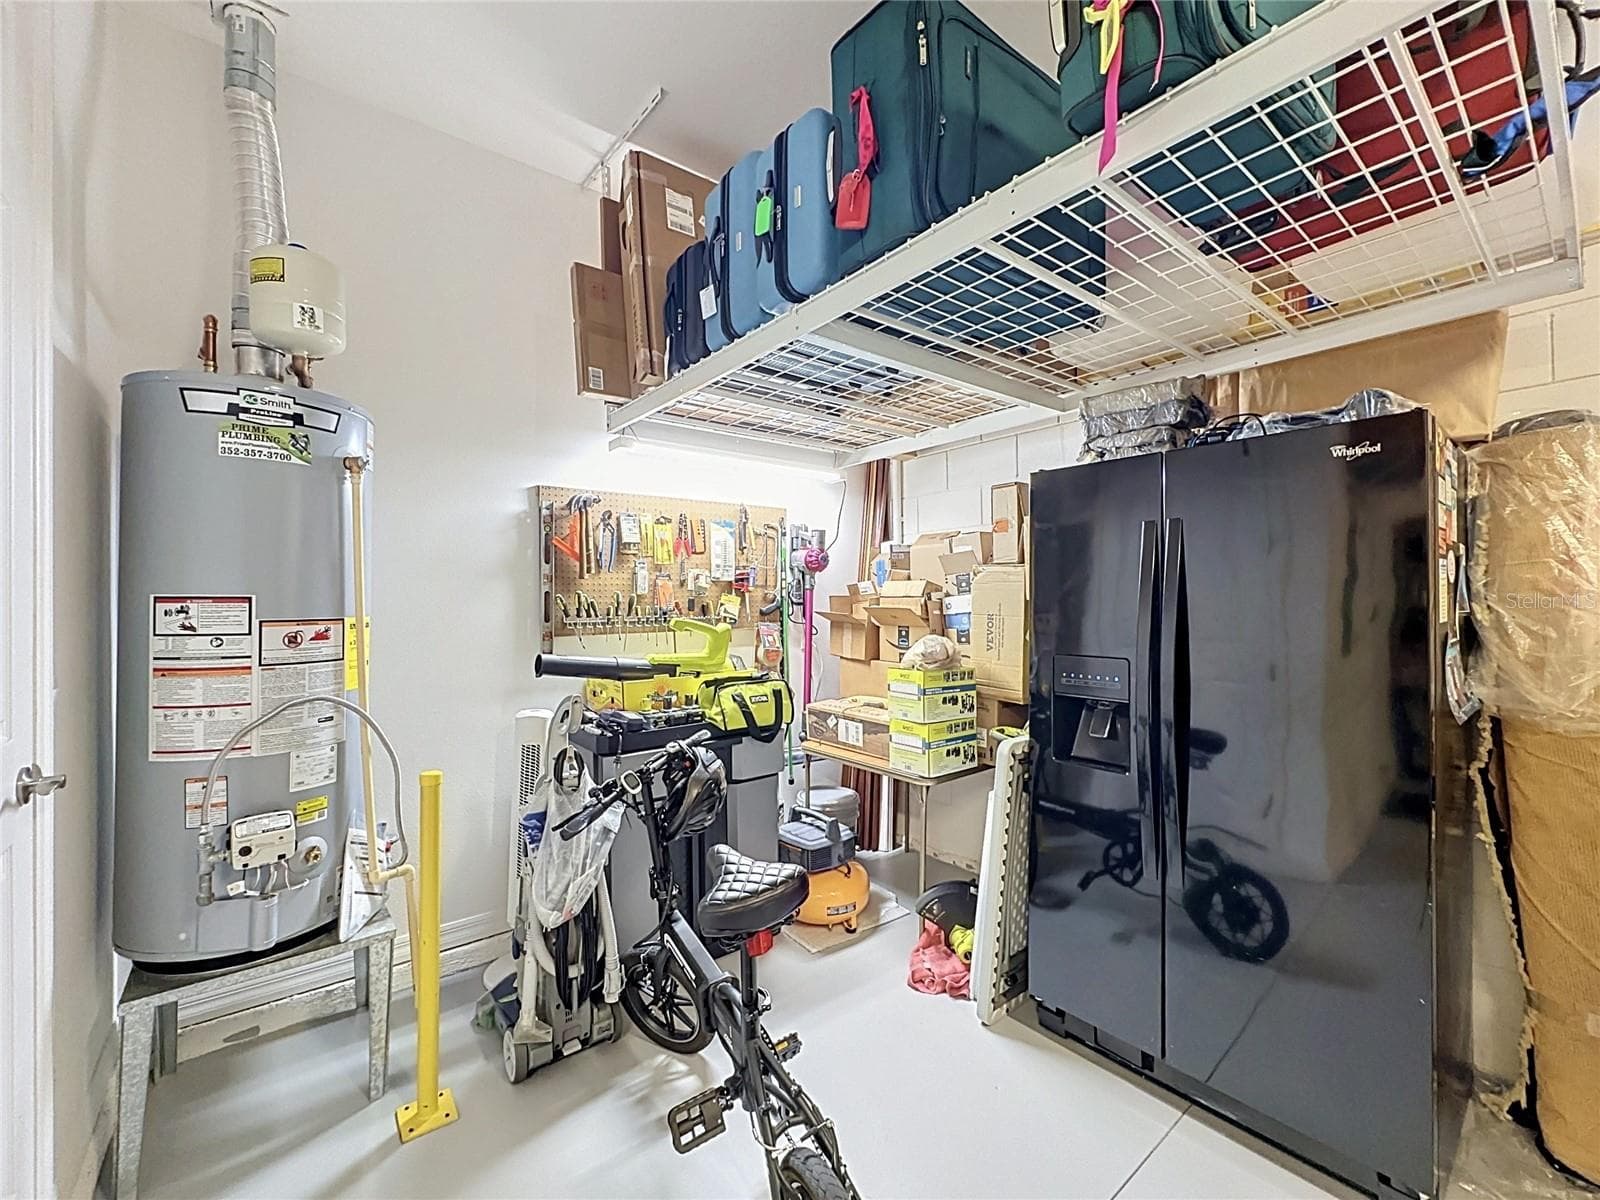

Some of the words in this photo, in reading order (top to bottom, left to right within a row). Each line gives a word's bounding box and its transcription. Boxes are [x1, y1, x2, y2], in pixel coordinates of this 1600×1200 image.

[260, 397, 291, 410] Smith
[232, 423, 269, 435] PRIME
[221, 430, 281, 444] PLUMBING
[220, 446, 292, 461] 352-357-3700
[1329, 441, 1381, 460] Whirlpool
[986, 613, 994, 651] VEVOR
